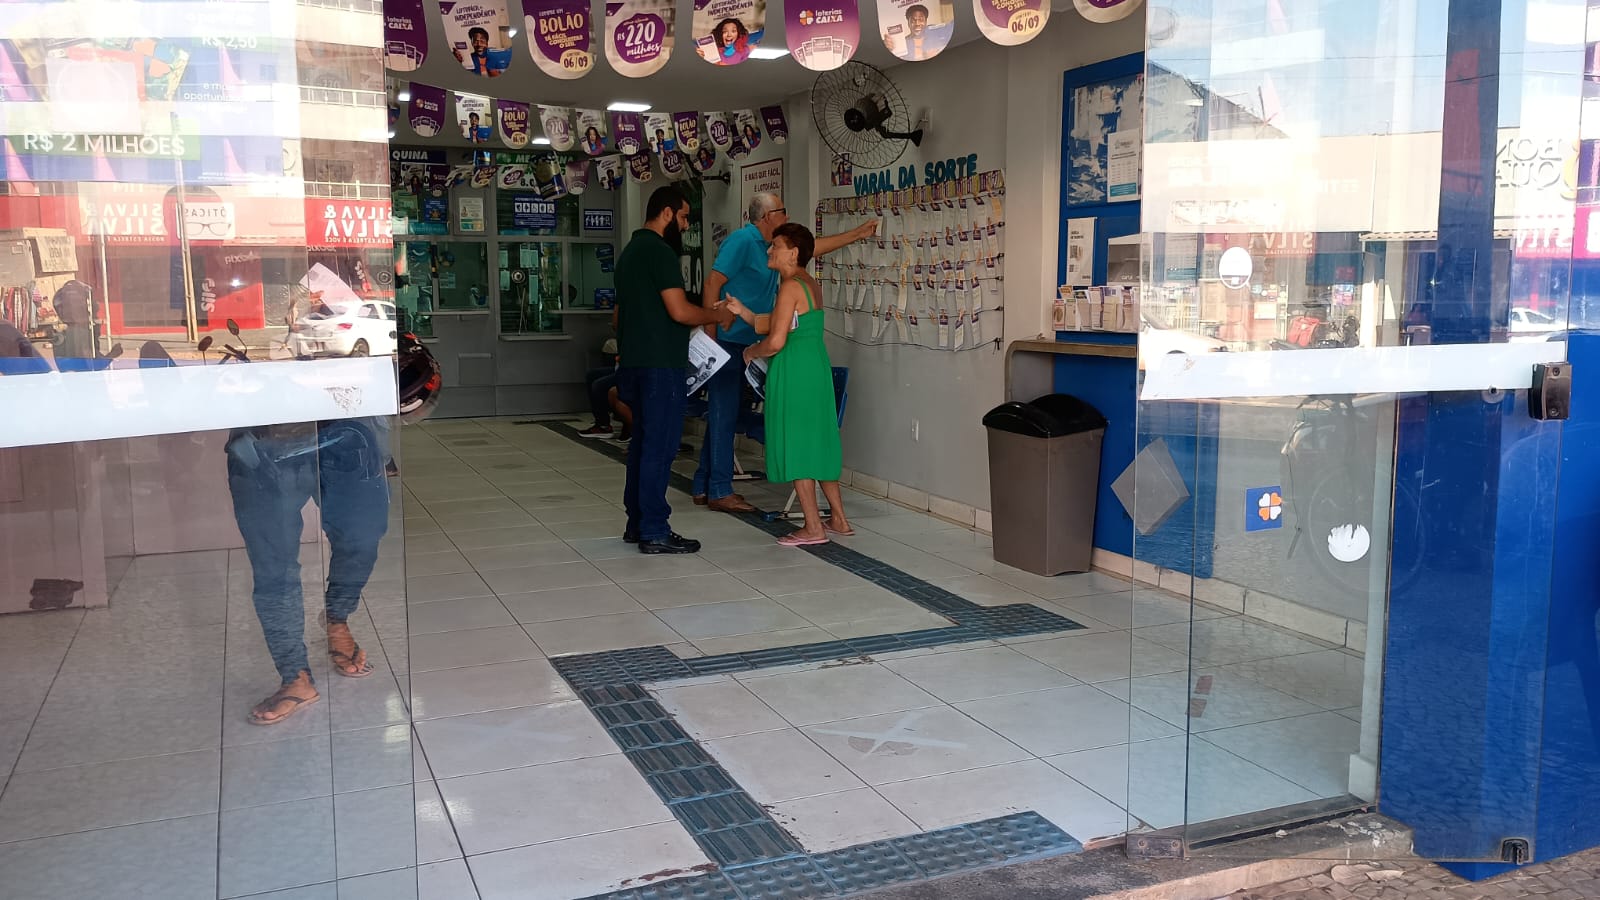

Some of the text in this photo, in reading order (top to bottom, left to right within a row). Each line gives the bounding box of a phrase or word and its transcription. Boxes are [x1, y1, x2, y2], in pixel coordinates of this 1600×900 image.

[815, 8, 842, 17] loterias
[815, 15, 843, 24] CAIXA
[388, 22, 413, 30] CAIXA
[540, 12, 584, 35] BOLÃO
[1011, 15, 1039, 33] 06/09
[625, 21, 656, 47] 220
[626, 42, 662, 57] milhões
[563, 56, 588, 69] 06/09
[24, 132, 185, 156] R$ 2 MILHÕES
[392, 150, 428, 160] QUINA
[853, 153, 977, 197] VARAL DA SORTE
